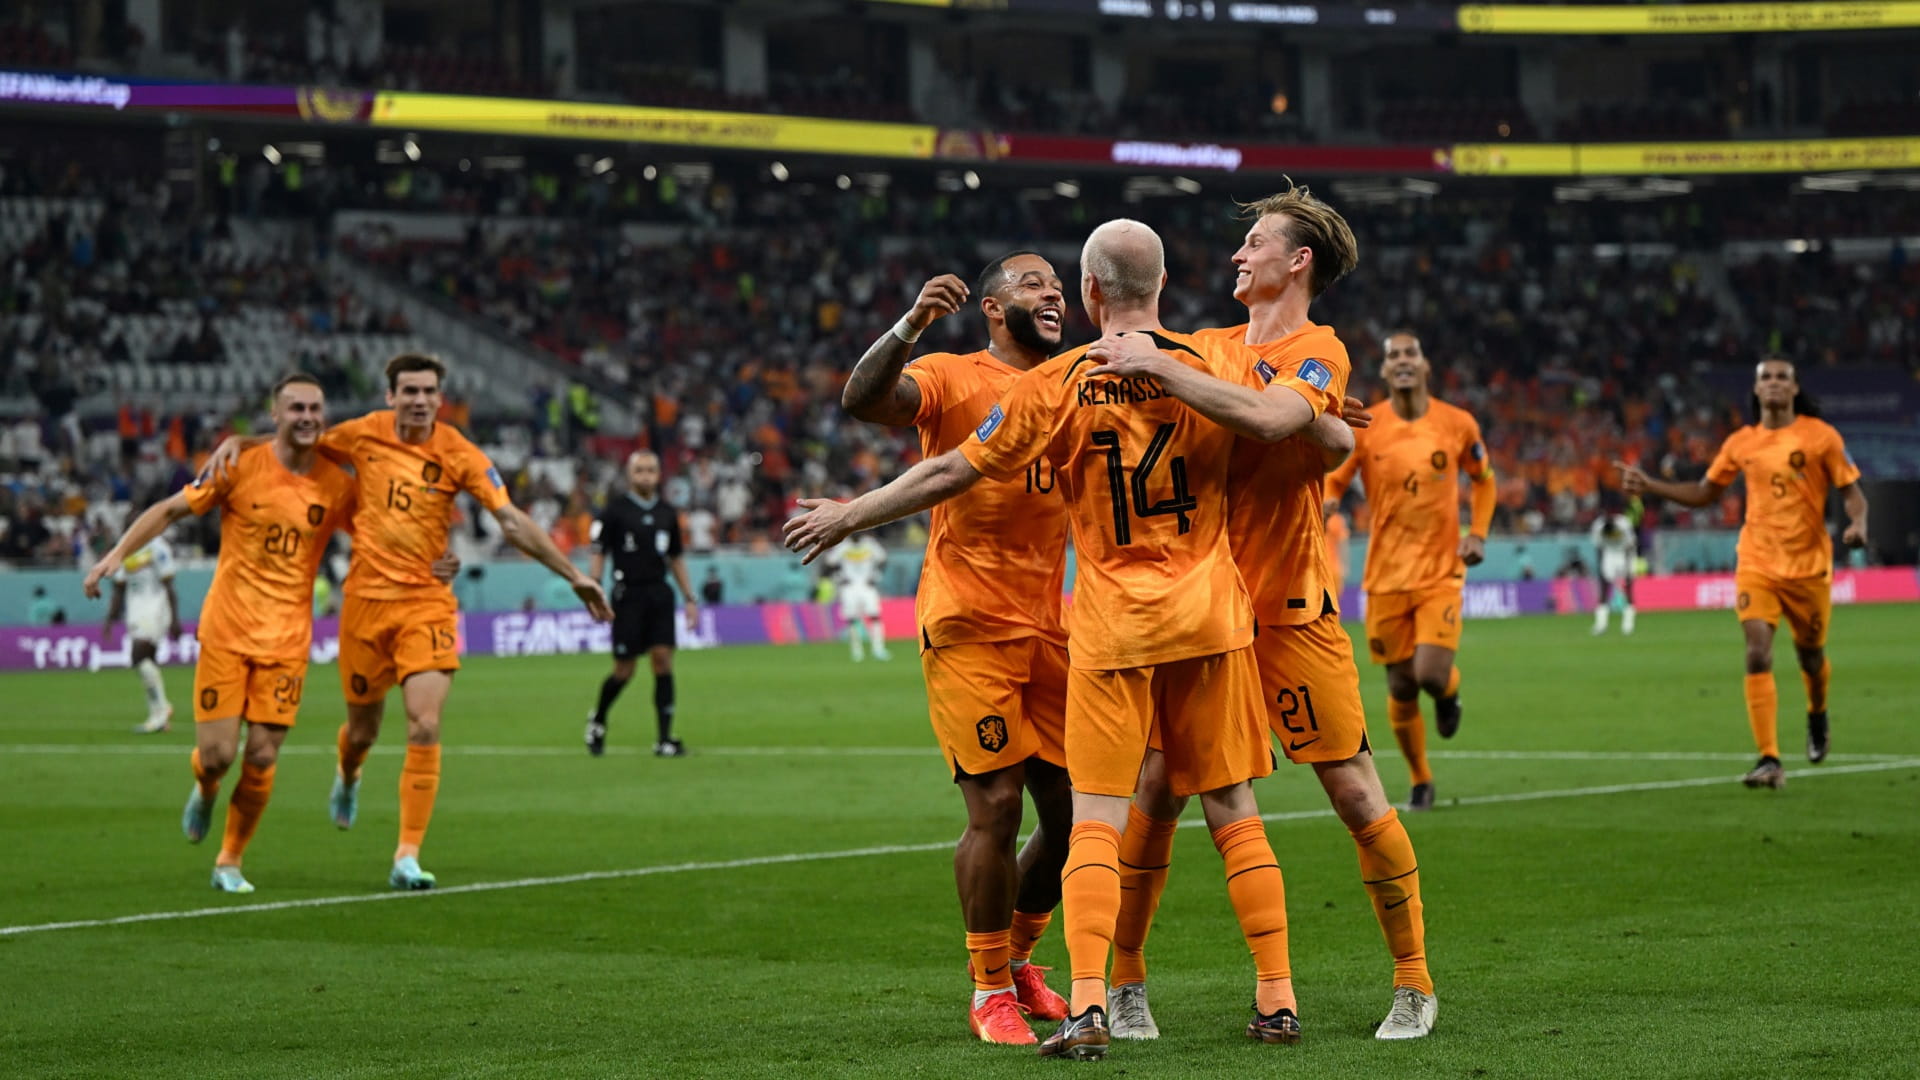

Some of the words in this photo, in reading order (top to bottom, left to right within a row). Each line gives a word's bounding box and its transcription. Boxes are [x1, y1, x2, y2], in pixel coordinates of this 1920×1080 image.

[1077, 377, 1173, 407] KLAASS
[1026, 458, 1055, 494] 10
[1091, 421, 1197, 546] 14
[1403, 469, 1418, 498] 4
[1770, 471, 1787, 500] 5
[387, 478, 412, 512] 15
[264, 523, 301, 557] 20
[429, 623, 456, 651] 15
[273, 674, 303, 706] 20
[1276, 685, 1320, 734] 21
